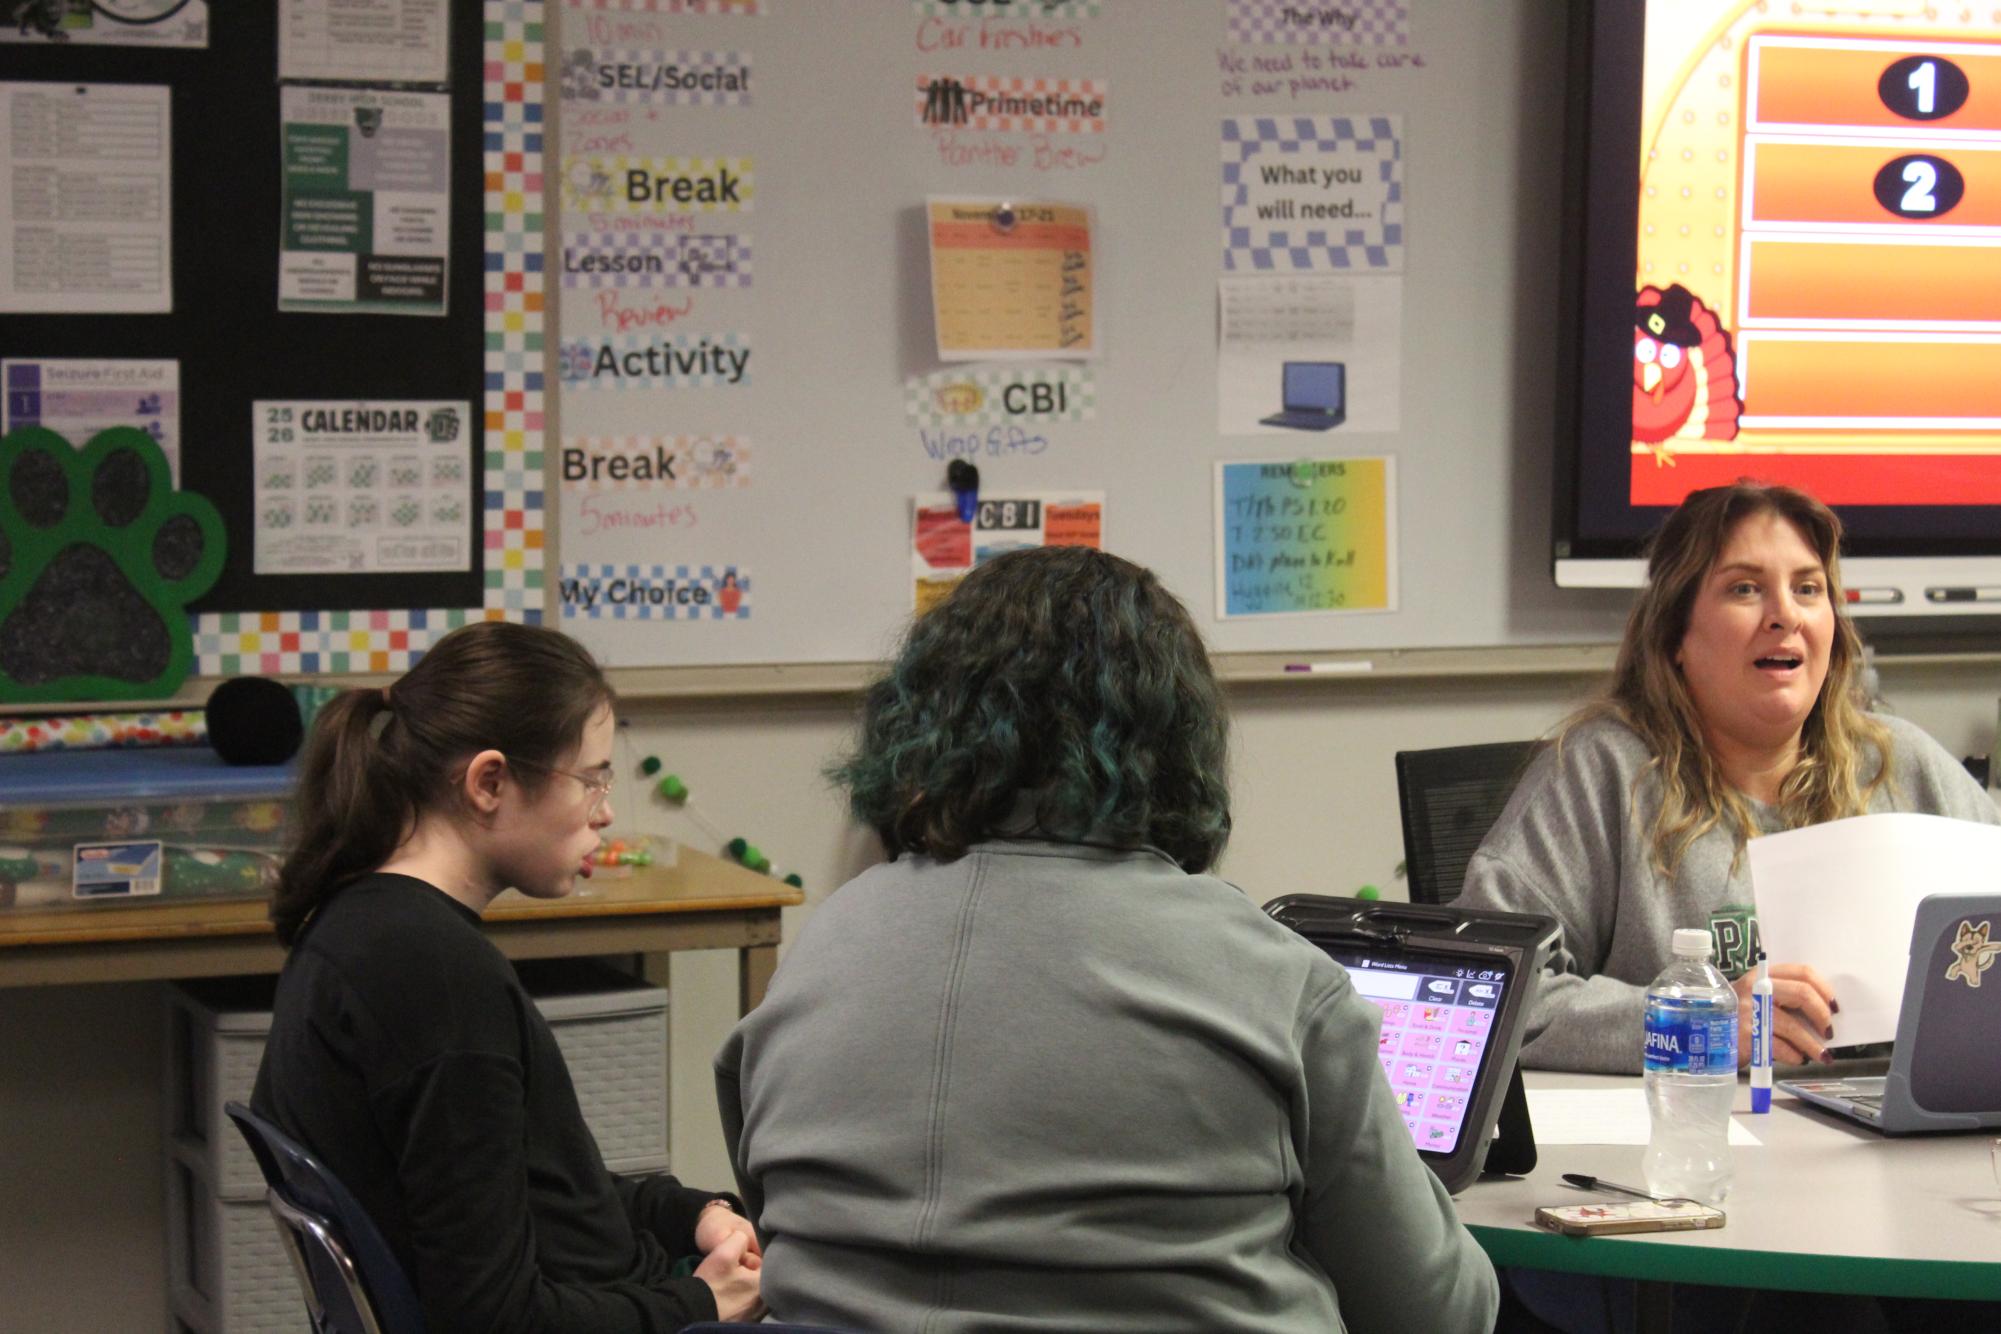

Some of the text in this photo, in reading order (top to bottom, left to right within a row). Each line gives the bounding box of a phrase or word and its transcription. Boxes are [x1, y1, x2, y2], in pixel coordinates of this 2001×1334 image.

[1282, 7, 1314, 25] The
[1252, 54, 1293, 72] need
[1301, 49, 1321, 70] to
[1328, 50, 1369, 70] take
[1376, 53, 1427, 68] care
[599, 63, 749, 92] SEL/Social
[1908, 62, 1936, 113] 1
[970, 91, 1102, 117] Primetime
[626, 168, 741, 203] Break
[1260, 165, 1363, 190] What you
[1900, 160, 1937, 212] 2
[1257, 198, 1372, 219] will need...
[563, 248, 663, 274] Lesson
[596, 289, 693, 333] Review
[593, 341, 750, 384] Activity
[1002, 381, 1067, 415] CBI
[267, 407, 293, 424] 25
[301, 409, 419, 433] CALENDAR
[267, 427, 294, 443] 26
[562, 446, 677, 482] Break
[1259, 462, 1347, 479] REMERS
[979, 503, 1034, 528] CBI
[559, 578, 709, 611] My Choice
